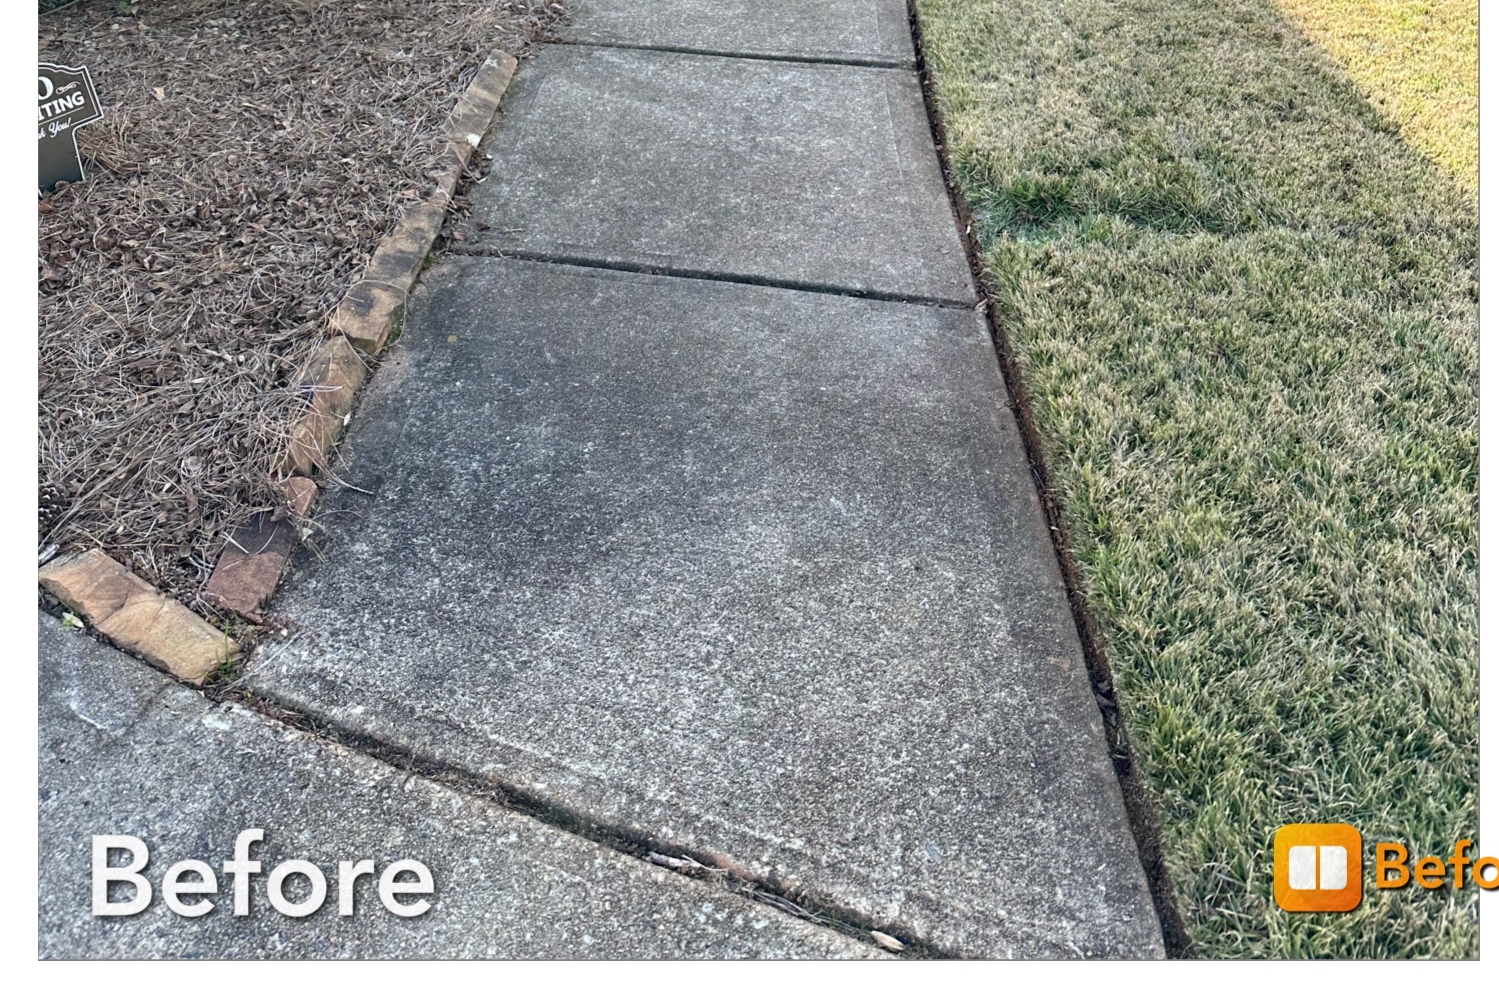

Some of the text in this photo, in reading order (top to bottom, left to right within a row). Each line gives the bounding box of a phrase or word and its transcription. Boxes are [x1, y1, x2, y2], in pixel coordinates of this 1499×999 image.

[38, 76, 54, 100] O
[38, 91, 85, 121] ITING
[48, 117, 72, 138] You!
